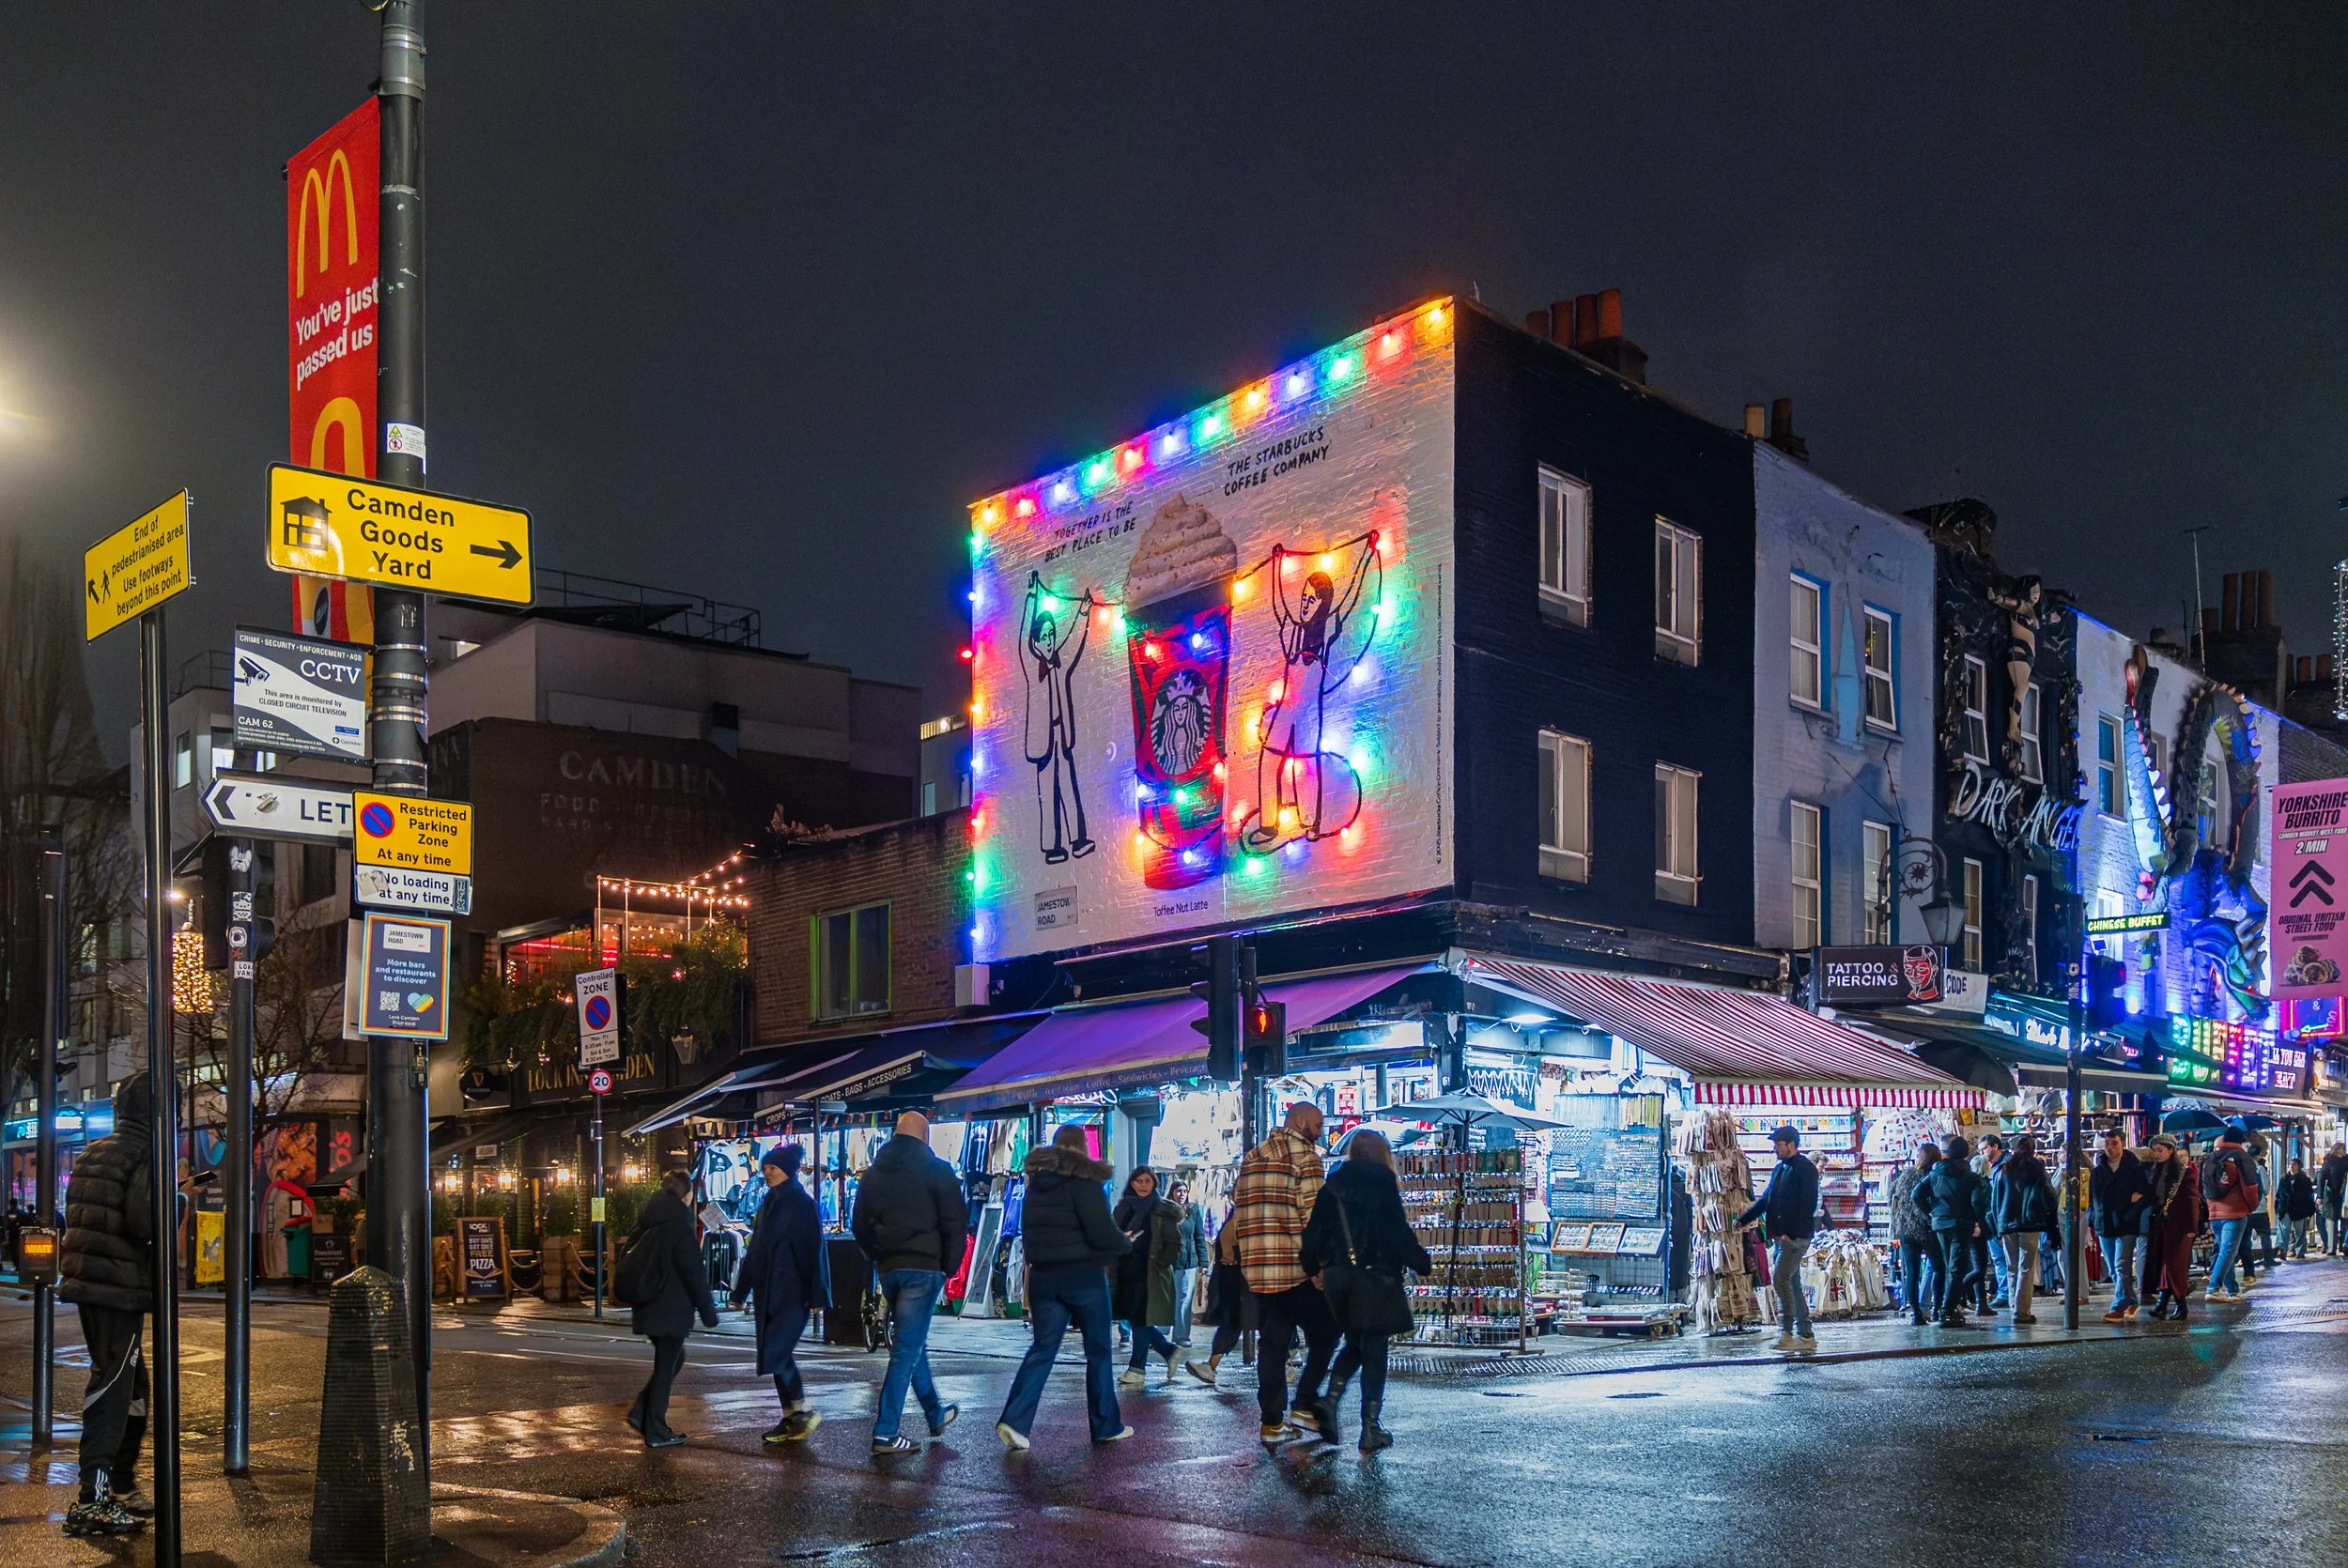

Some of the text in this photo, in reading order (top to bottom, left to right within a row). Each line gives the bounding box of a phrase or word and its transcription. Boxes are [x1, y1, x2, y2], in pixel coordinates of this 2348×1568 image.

[296, 277, 379, 346] You've just
[297, 323, 373, 392] passed us
[1228, 426, 1323, 476] THE STARBUCKS
[1224, 445, 1329, 496] COFFEE COMPANY
[347, 488, 455, 527] Camden
[134, 515, 159, 543] End of
[1054, 500, 1134, 541] TOGETHER IS THE
[360, 519, 443, 553] Goods
[1045, 517, 1136, 562] BEST PLACE TO BE
[111, 523, 184, 578] pedestrianised area
[123, 555, 174, 592] Use footways
[372, 550, 432, 579] Yard
[116, 568, 181, 616] beyond this point
[239, 635, 260, 644] CRIME
[264, 638, 296, 651] SECURITY
[300, 645, 346, 659] ENFORCEMENT
[301, 659, 362, 684] CCTV
[259, 698, 347, 717] CLOSED CIRCUIT TELEVISION
[264, 689, 278, 698] This
[301, 695, 333, 706] monitored
[334, 699, 343, 708] by
[238, 716, 273, 729] CAM 62
[559, 750, 726, 795] CAMDEN
[300, 798, 352, 825] LET
[399, 803, 467, 821] Restricted
[2278, 791, 2348, 814] YORKSHIRE
[409, 819, 458, 836] Parking
[2284, 809, 2341, 830] BURRITO
[418, 834, 449, 847] Zone
[2294, 838, 2328, 854] 2 MIN
[378, 848, 452, 867] At any time
[385, 873, 449, 892] No loading
[378, 888, 450, 905] at any time
[1153, 900, 1209, 917] Toffee Nut Latte
[2278, 911, 2346, 925] ORIGINAL BRITISH
[1037, 914, 1056, 926] ROAD
[2087, 914, 2164, 932] CHINESE BUFFET
[2285, 921, 2336, 934] STREET FOOD
[388, 930, 424, 940] JAMESTOWN
[386, 958, 425, 969] More bars
[392, 967, 437, 978] restaurants
[1826, 962, 1899, 975] TATTOO &
[394, 976, 427, 985] discover
[578, 971, 613, 984] Controlled
[1827, 975, 1898, 987] PIERCING
[1946, 974, 1968, 995] CODE
[583, 982, 609, 994] ZONE
[2280, 1047, 2294, 1068] YOU
[528, 1066, 563, 1092] LOCK
[594, 1077, 609, 1086] 20
[845, 1082, 863, 1097] BAGS
[867, 1063, 912, 1089] ACCESSORIES
[1086, 1077, 1111, 1088] Coffee
[1118, 1069, 1163, 1085] Sandwiches
[2274, 1070, 2296, 1089] EAT
[765, 1111, 786, 1126] CROPS
[471, 1258, 496, 1269] PIZZA
